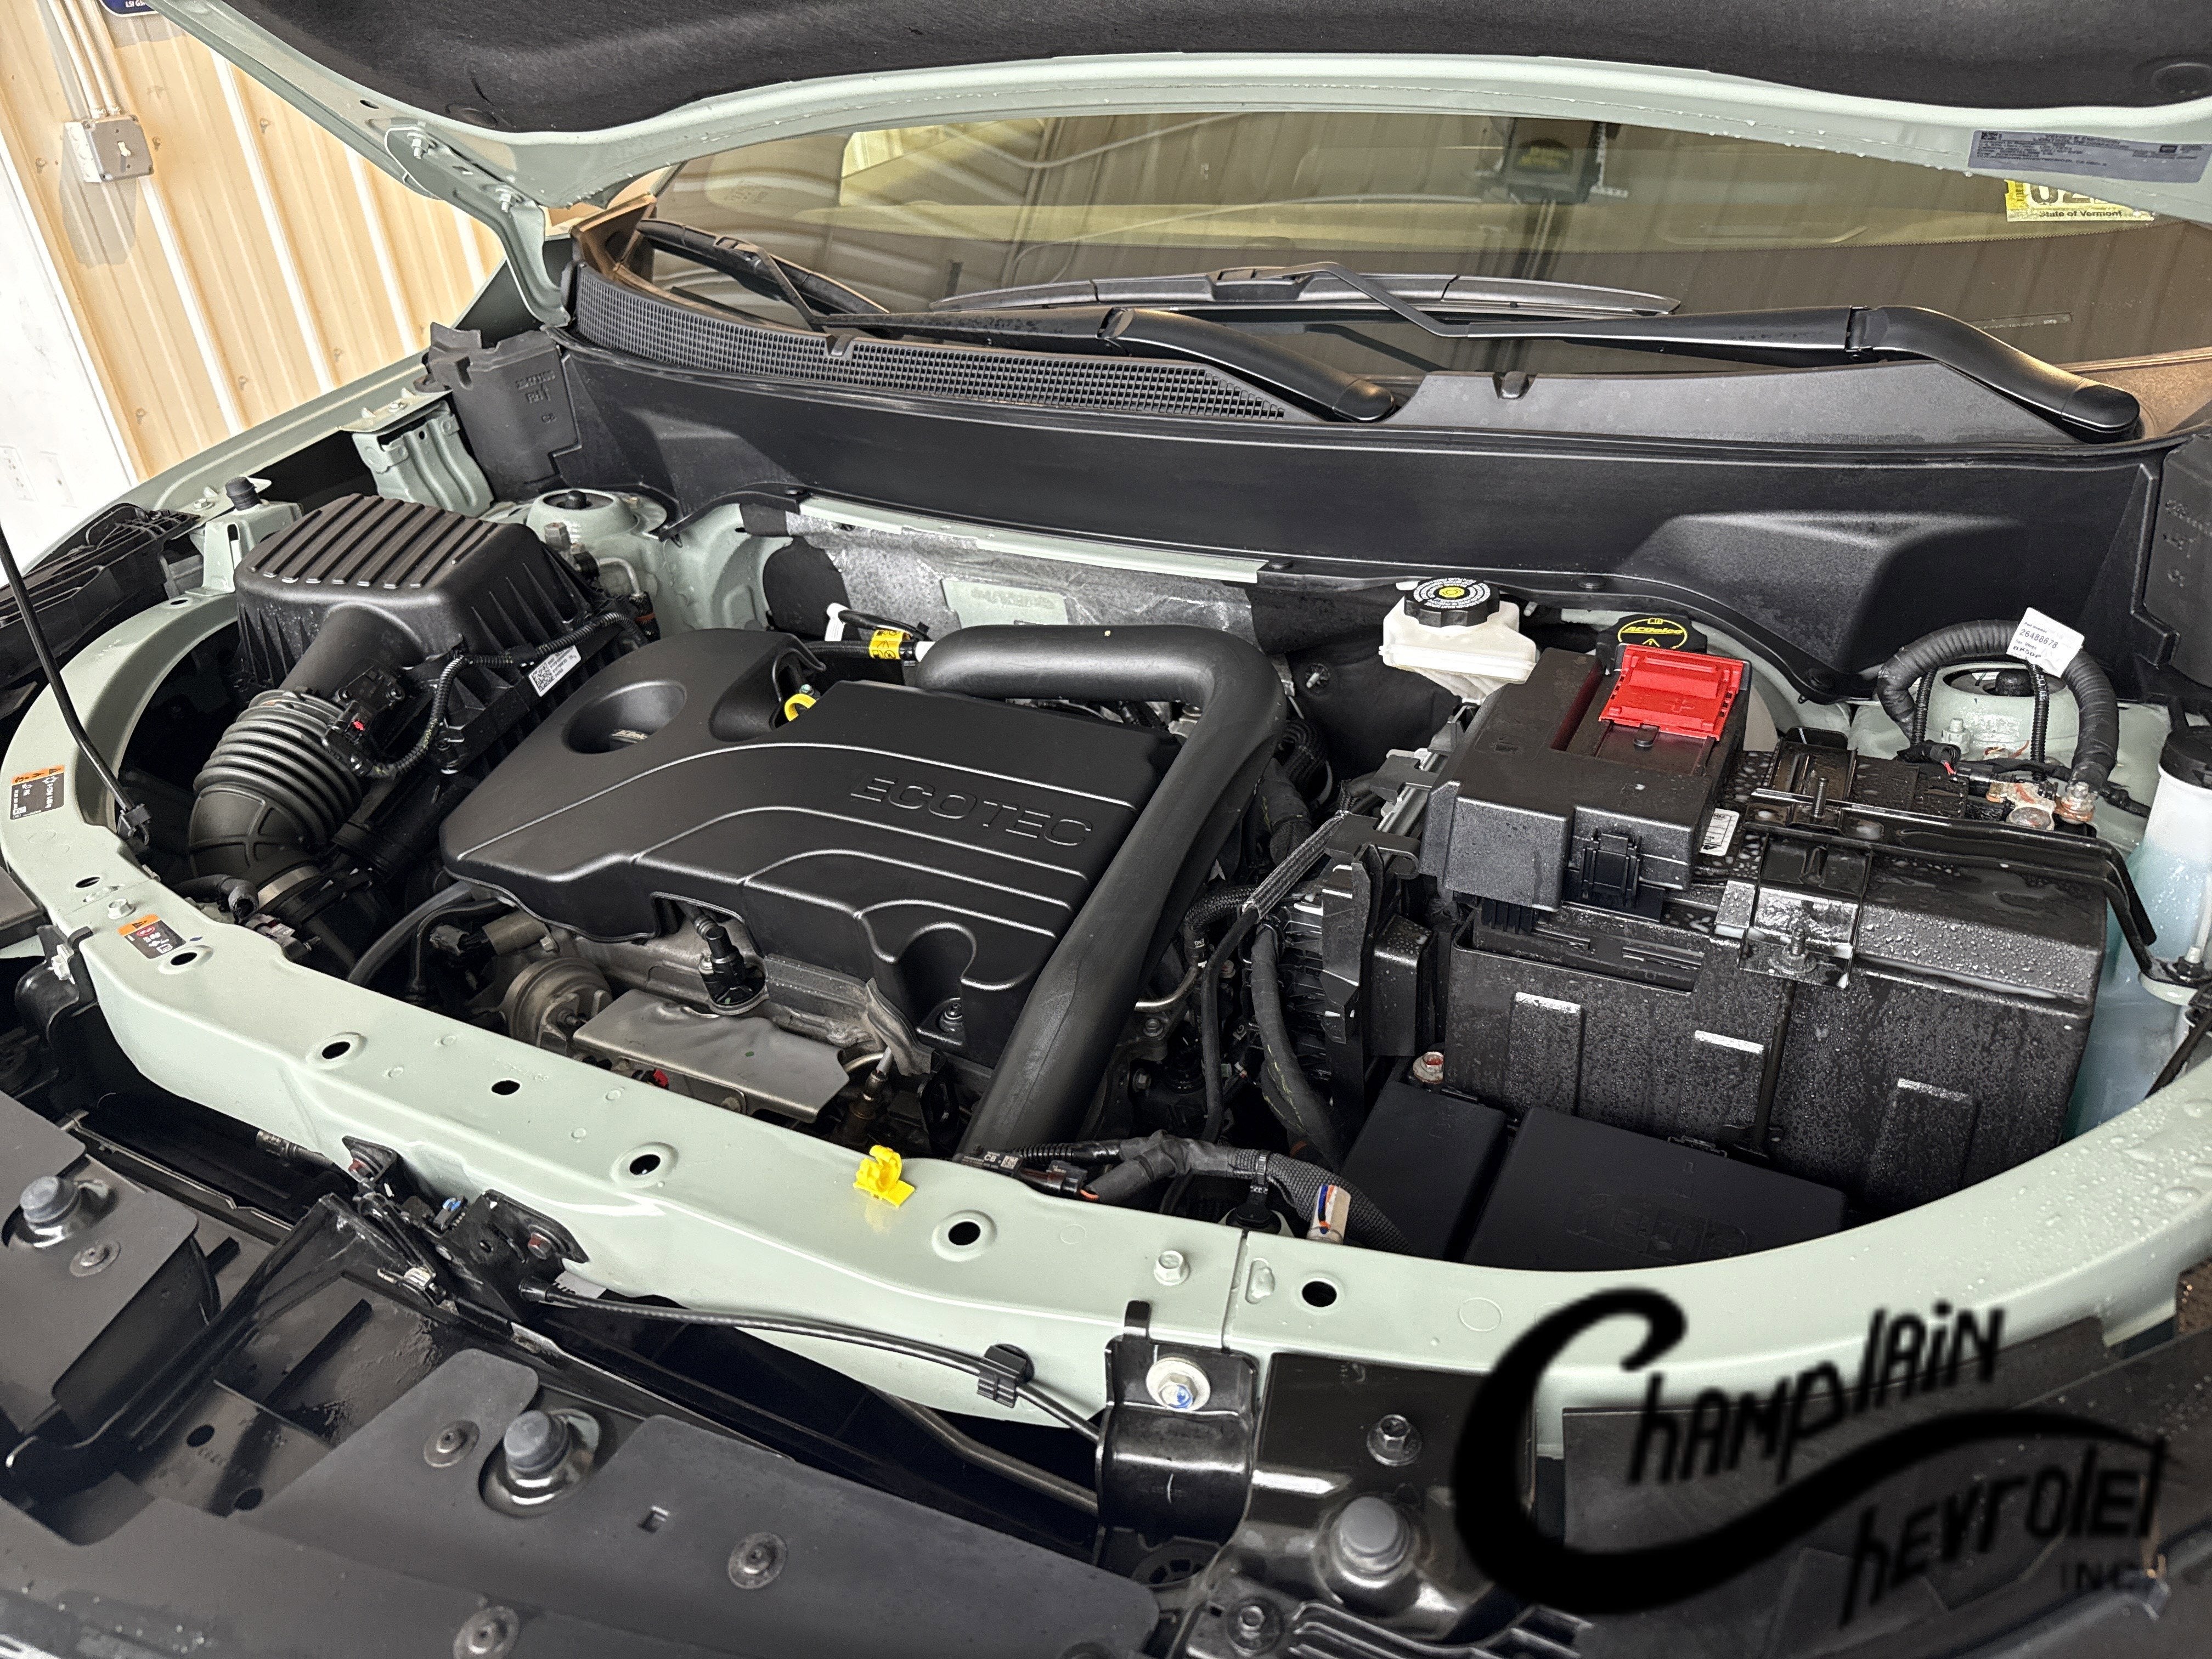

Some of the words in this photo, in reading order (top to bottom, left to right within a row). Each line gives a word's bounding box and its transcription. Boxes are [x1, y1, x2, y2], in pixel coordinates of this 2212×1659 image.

[1624, 627, 1684, 635] ACDelco
[2019, 629, 2058, 649] 26488678
[850, 775, 1093, 846] ECOTEC
